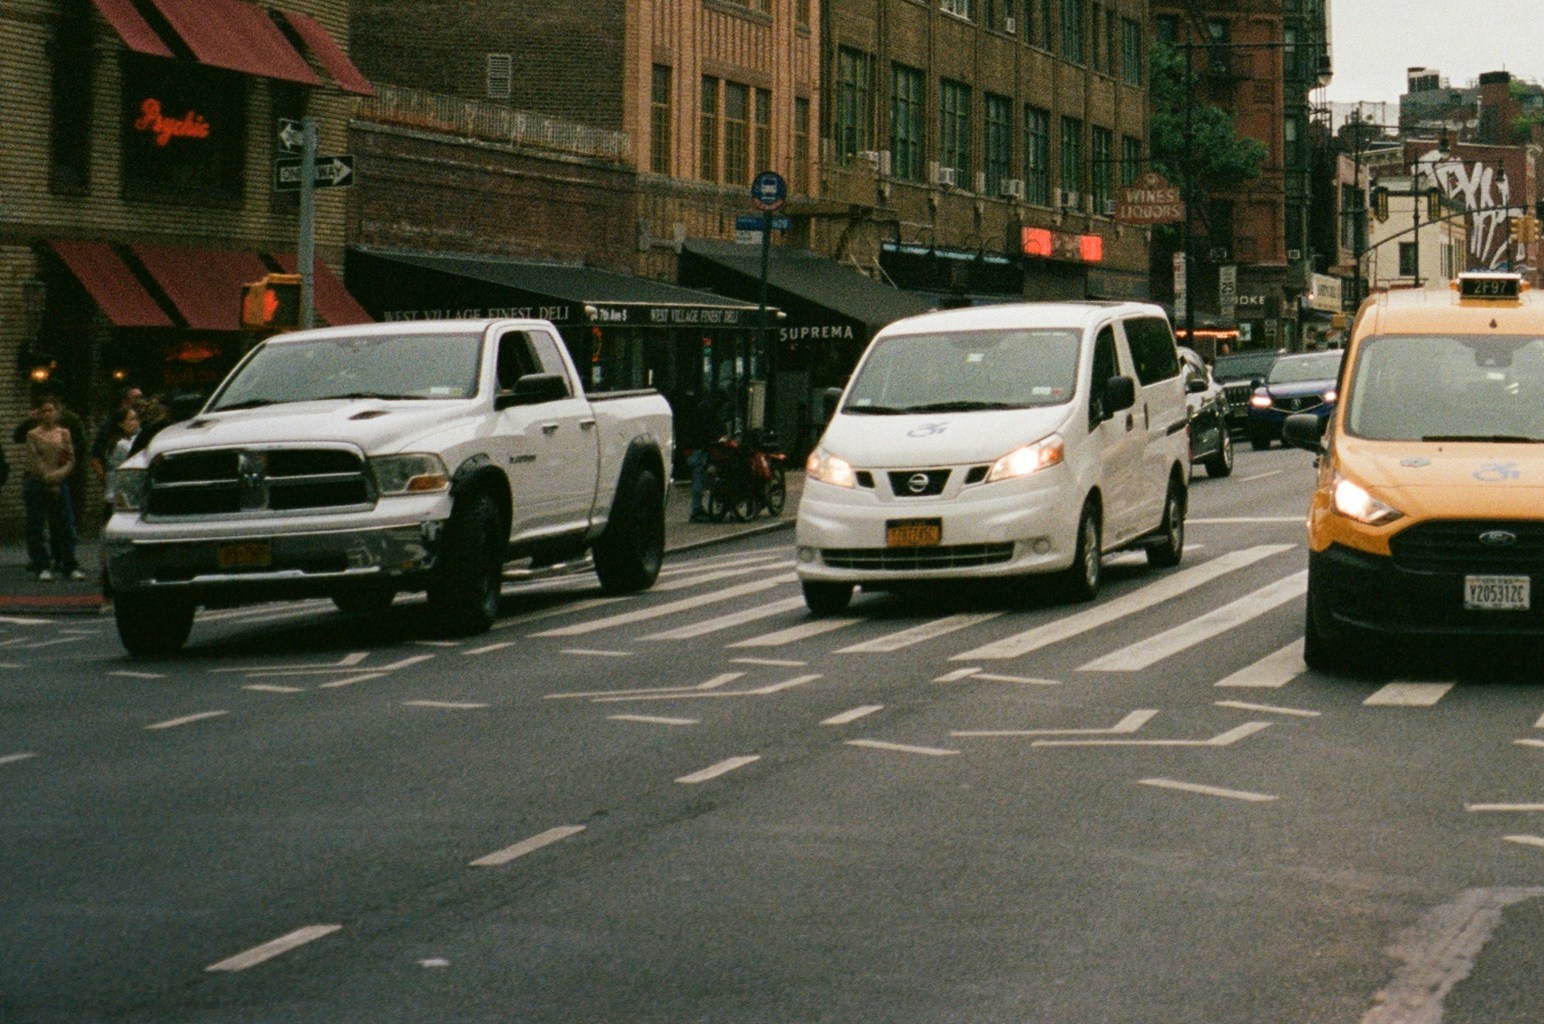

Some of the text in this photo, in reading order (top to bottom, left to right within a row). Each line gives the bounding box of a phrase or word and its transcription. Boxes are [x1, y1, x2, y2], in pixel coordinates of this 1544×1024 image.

[1126, 189, 1175, 204] WINES
[1120, 205, 1181, 219] LIQUORS
[1221, 281, 1235, 294] 25
[1474, 280, 1507, 294] 2F97
[384, 310, 417, 322] WEST
[424, 309, 481, 320] VILLAGE
[488, 307, 533, 319] FINEST
[539, 306, 569, 321] DELI
[651, 308, 669, 322] WEST
[671, 309, 699, 323] VILLAGE
[779, 326, 853, 342] SUPREMA
